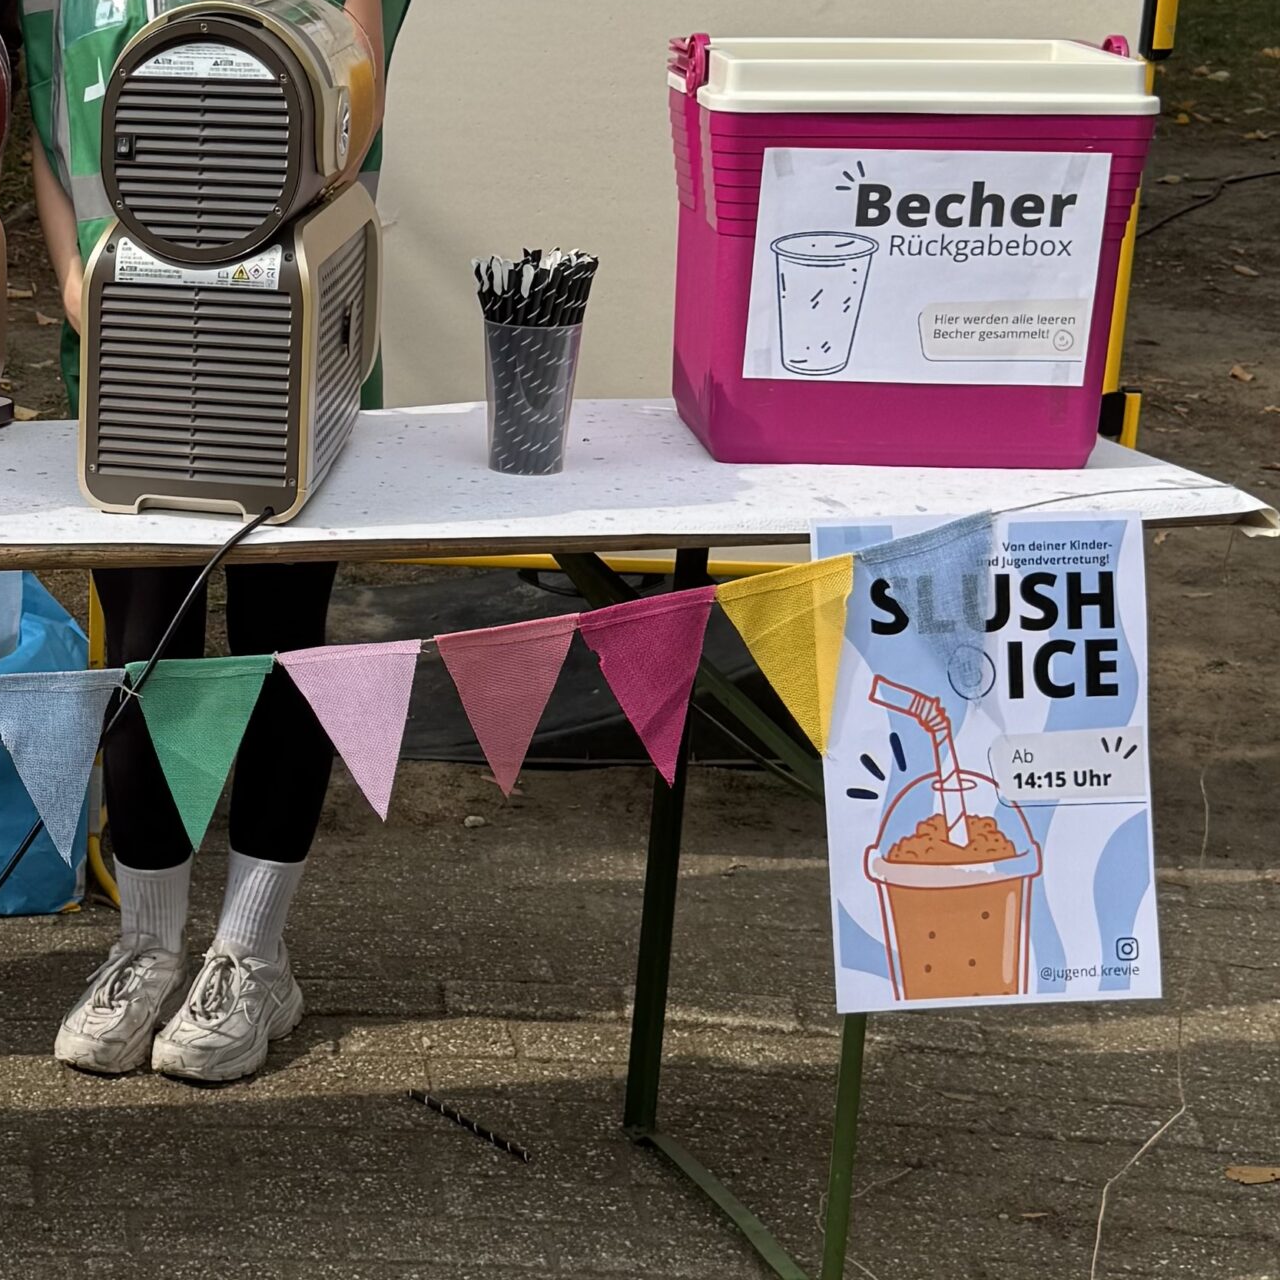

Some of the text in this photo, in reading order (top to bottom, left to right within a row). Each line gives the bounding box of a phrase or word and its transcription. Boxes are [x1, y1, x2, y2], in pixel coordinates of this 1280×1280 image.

[855, 181, 1078, 228] Becher
[889, 233, 1073, 263] Rückgabebox
[934, 314, 1076, 325] Hier werden alle leeren
[933, 328, 1050, 341] Becher gesammelt!
[1002, 540, 1113, 552] Von deiner Kinder-
[1001, 554, 1110, 569] Jugendvertretung!
[1007, 638, 1119, 699] ICE
[1011, 749, 1035, 765] Ab
[1012, 770, 1113, 789] 14:15 Uhr
[1040, 963, 1140, 982] @jugend.krevie
